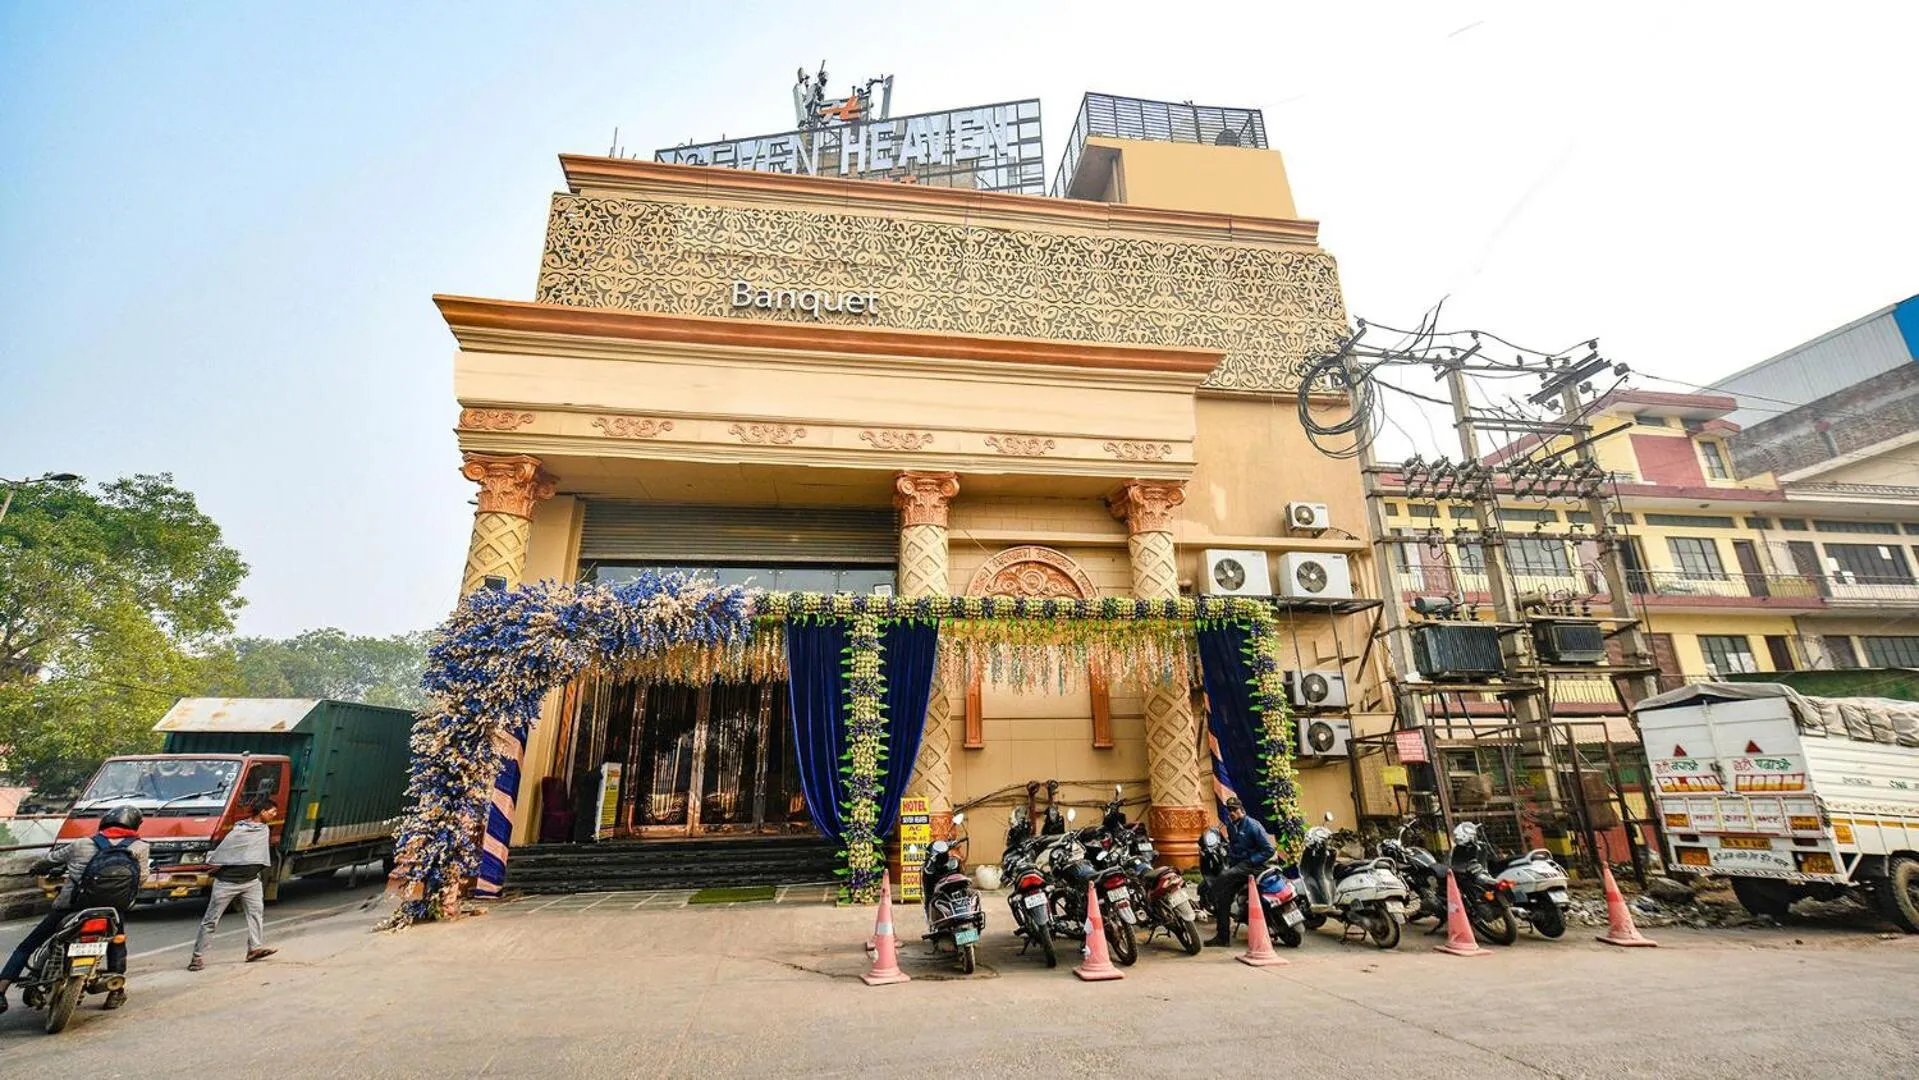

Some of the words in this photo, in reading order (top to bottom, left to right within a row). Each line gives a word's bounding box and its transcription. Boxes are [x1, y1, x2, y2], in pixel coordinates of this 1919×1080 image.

[839, 107, 1009, 175] HEAVEN
[731, 280, 879, 318] Banquet
[902, 800, 927, 812] HOTEL
